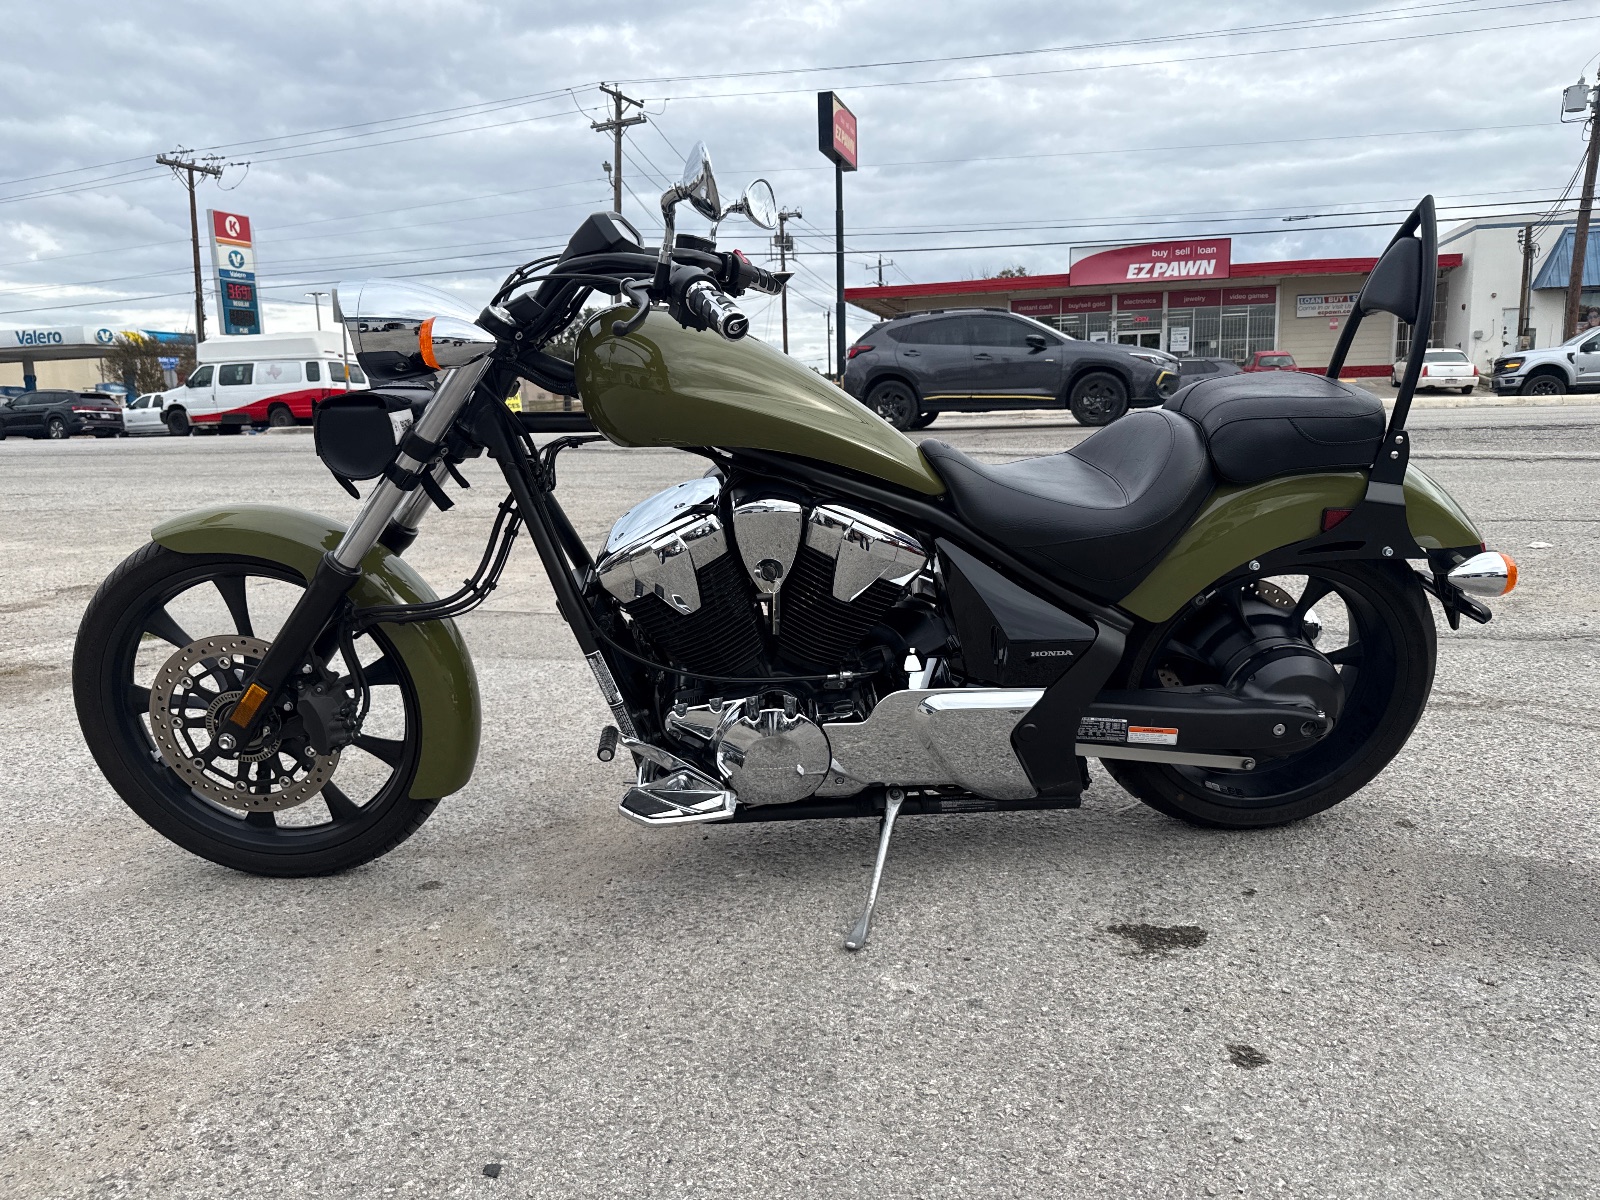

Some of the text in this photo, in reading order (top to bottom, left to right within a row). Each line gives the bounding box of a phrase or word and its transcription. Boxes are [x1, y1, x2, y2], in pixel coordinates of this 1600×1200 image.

[1151, 246, 1217, 258] buy sell loan
[229, 270, 247, 278] Valero
[1126, 259, 1217, 279] EZPAWN
[1123, 297, 1157, 305] electronics
[15, 330, 63, 345] Valero
